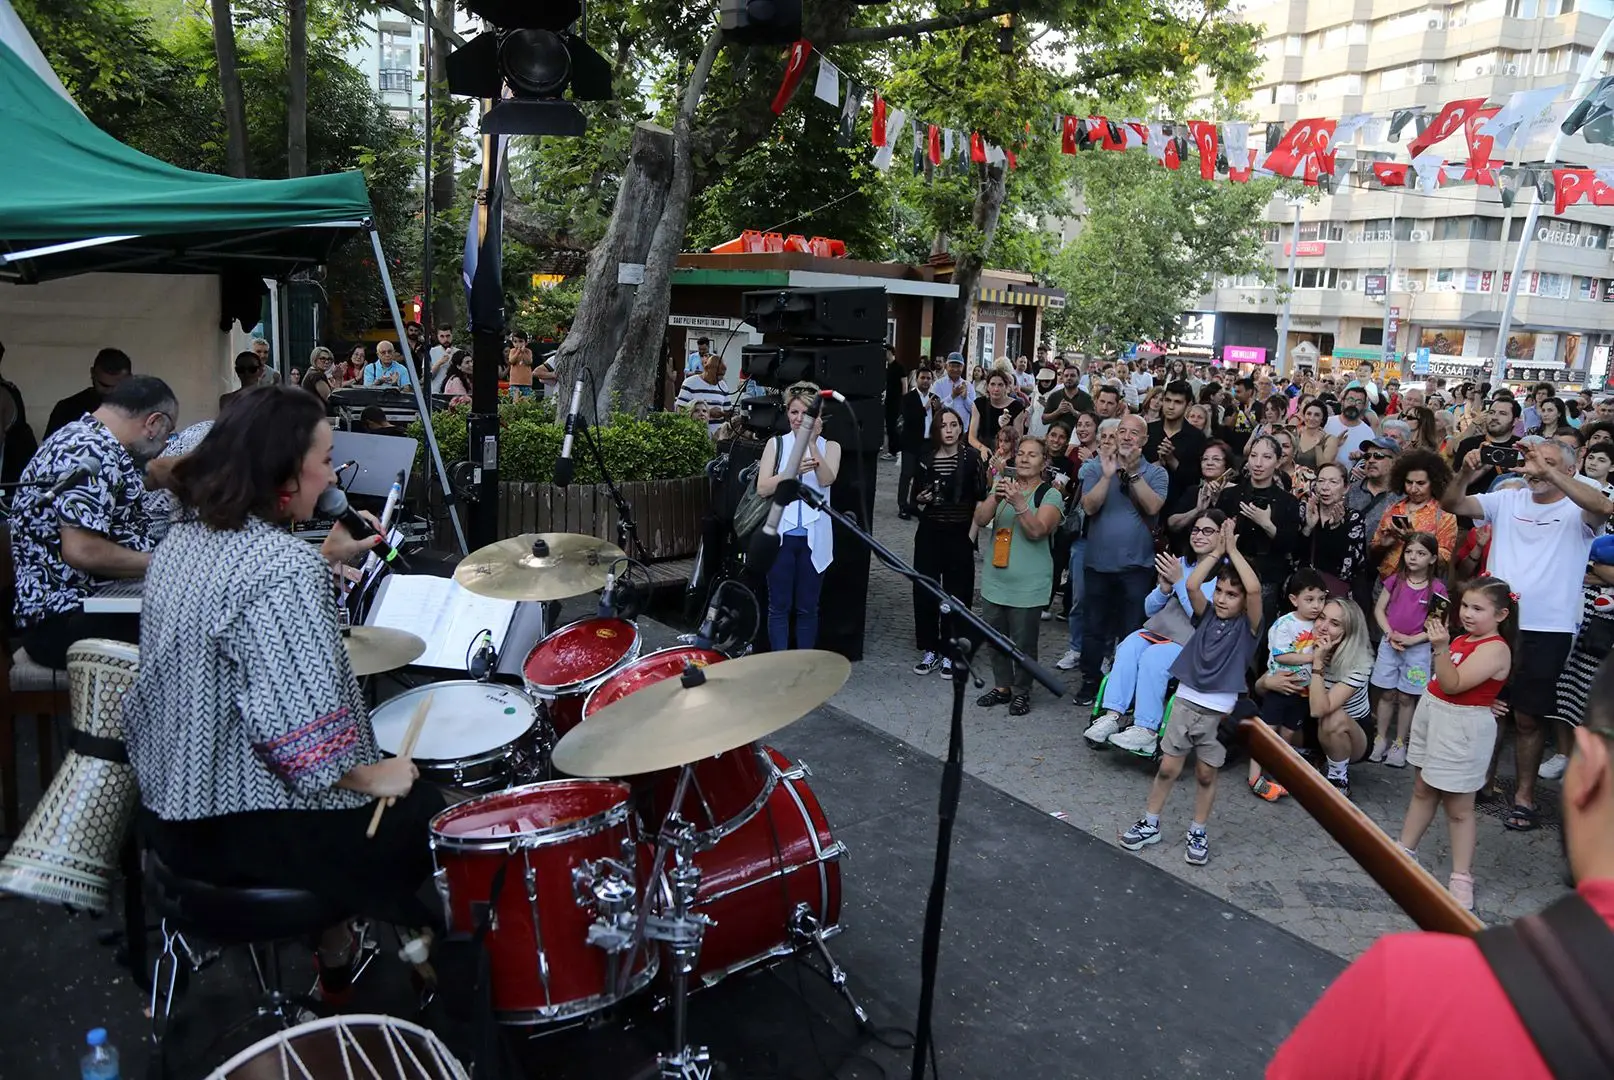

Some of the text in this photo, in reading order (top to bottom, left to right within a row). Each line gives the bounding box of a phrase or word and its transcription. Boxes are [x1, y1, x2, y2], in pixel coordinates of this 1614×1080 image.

[1346, 230, 1392, 244] CHELEB
[1410, 362, 1469, 376] GBÜZ SAAT
